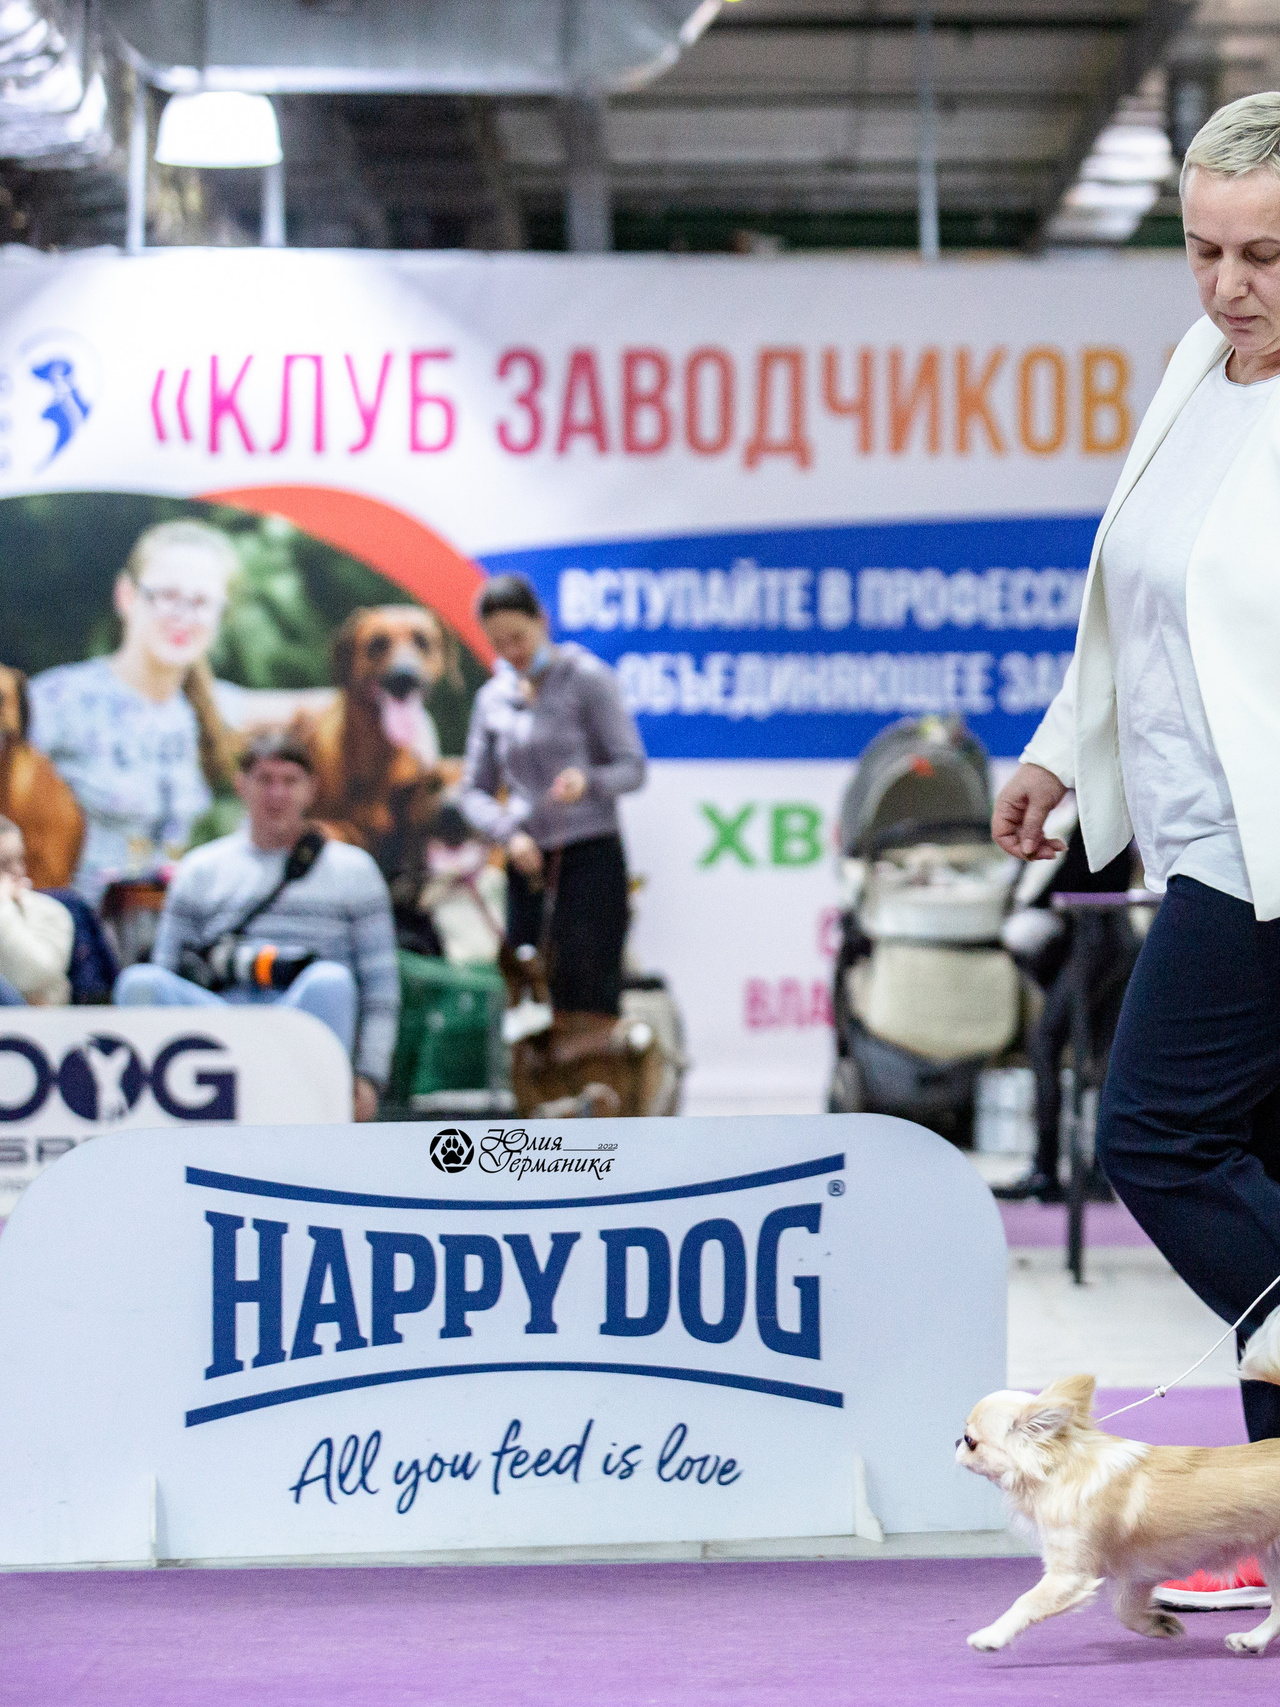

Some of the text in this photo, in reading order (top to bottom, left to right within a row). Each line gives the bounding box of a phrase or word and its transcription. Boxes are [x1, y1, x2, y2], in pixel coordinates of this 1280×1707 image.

[151, 348, 457, 455] «КЛУБ
[496, 345, 1133, 470] ЗАВОДЧИКОВ
[559, 557, 812, 630] ВСТУПАЙТЕ
[818, 567, 853, 630] В
[205, 1203, 822, 1379] HAPPY DOG
[289, 1418, 744, 1514] All you feed is love
